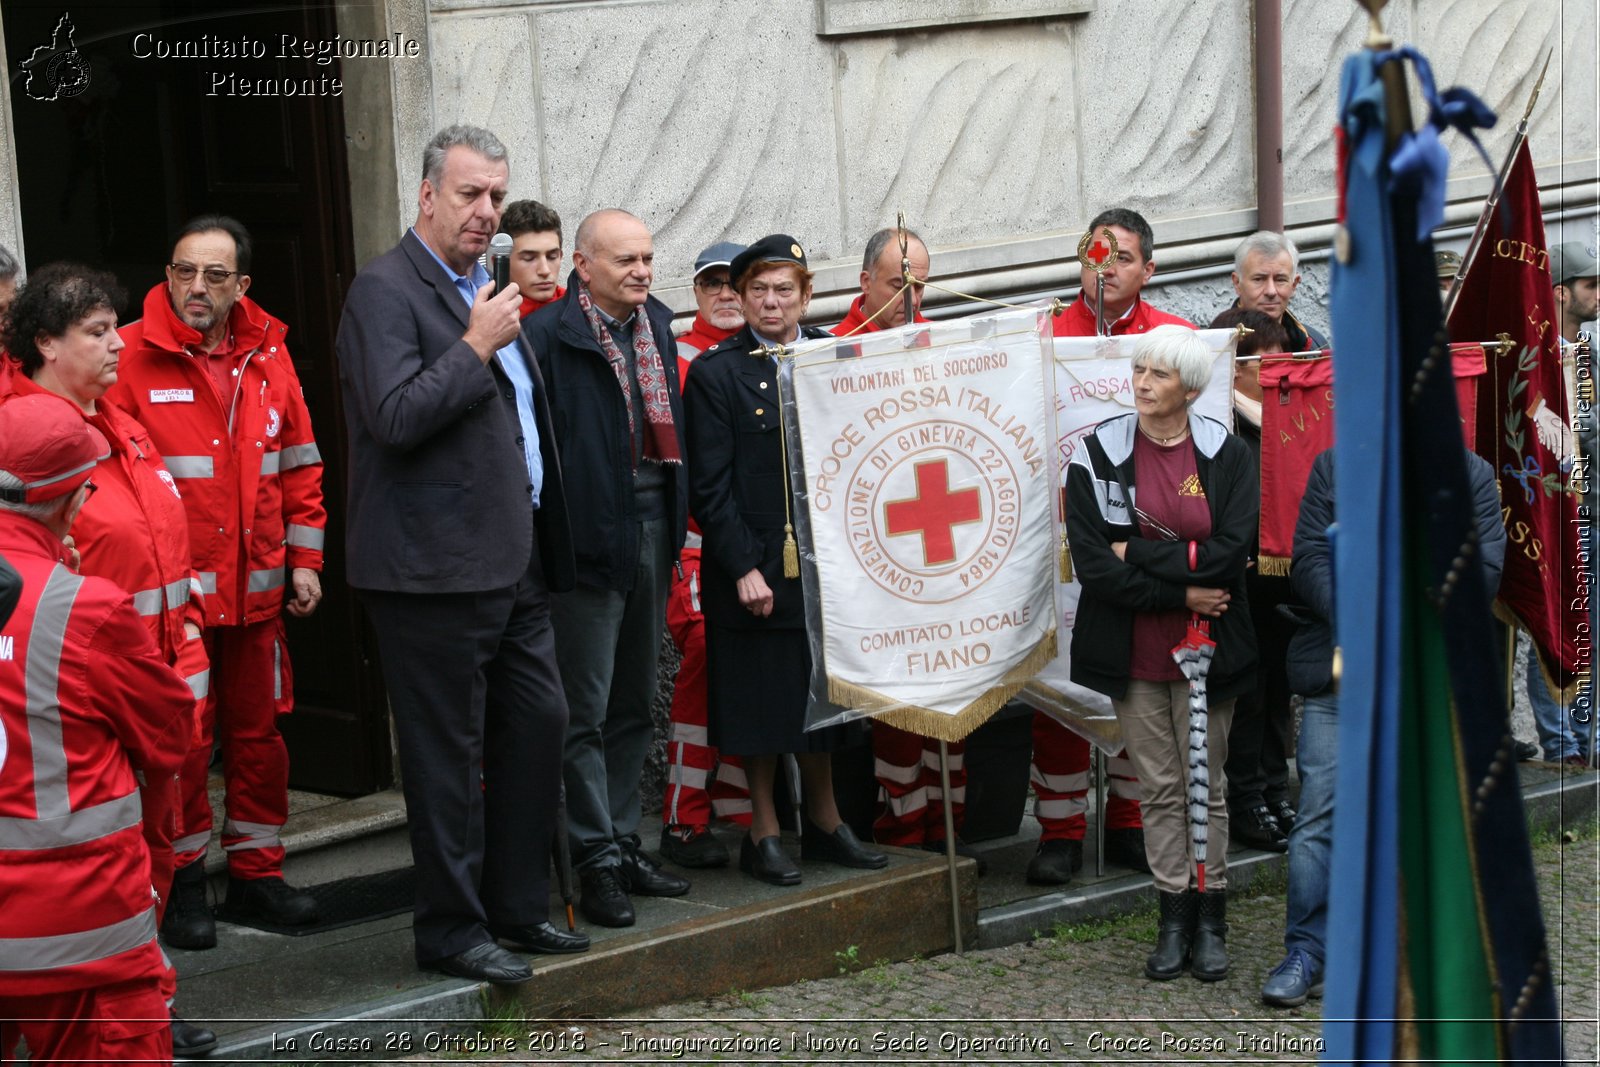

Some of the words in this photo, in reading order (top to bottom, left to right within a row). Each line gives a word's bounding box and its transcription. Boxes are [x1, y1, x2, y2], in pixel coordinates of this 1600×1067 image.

[830, 368, 906, 395] VOLONTARI
[913, 364, 938, 384] DEL
[943, 351, 1009, 378] SOCCORSO
[1069, 376, 1131, 403] ROSSA
[814, 423, 866, 512] CROCE
[863, 384, 952, 431] ROSSA
[957, 386, 1045, 478] ITALIANA
[897, 424, 978, 452] GINEVRA
[870, 448, 894, 471] DI
[979, 448, 1004, 474] 22
[991, 476, 1016, 548] AGOSTO
[850, 476, 925, 596] CONVENZIONE
[958, 550, 1000, 590] 1864
[860, 622, 953, 654] COMITATO
[959, 605, 1032, 636] LOCALE
[906, 641, 992, 676] FIANO
